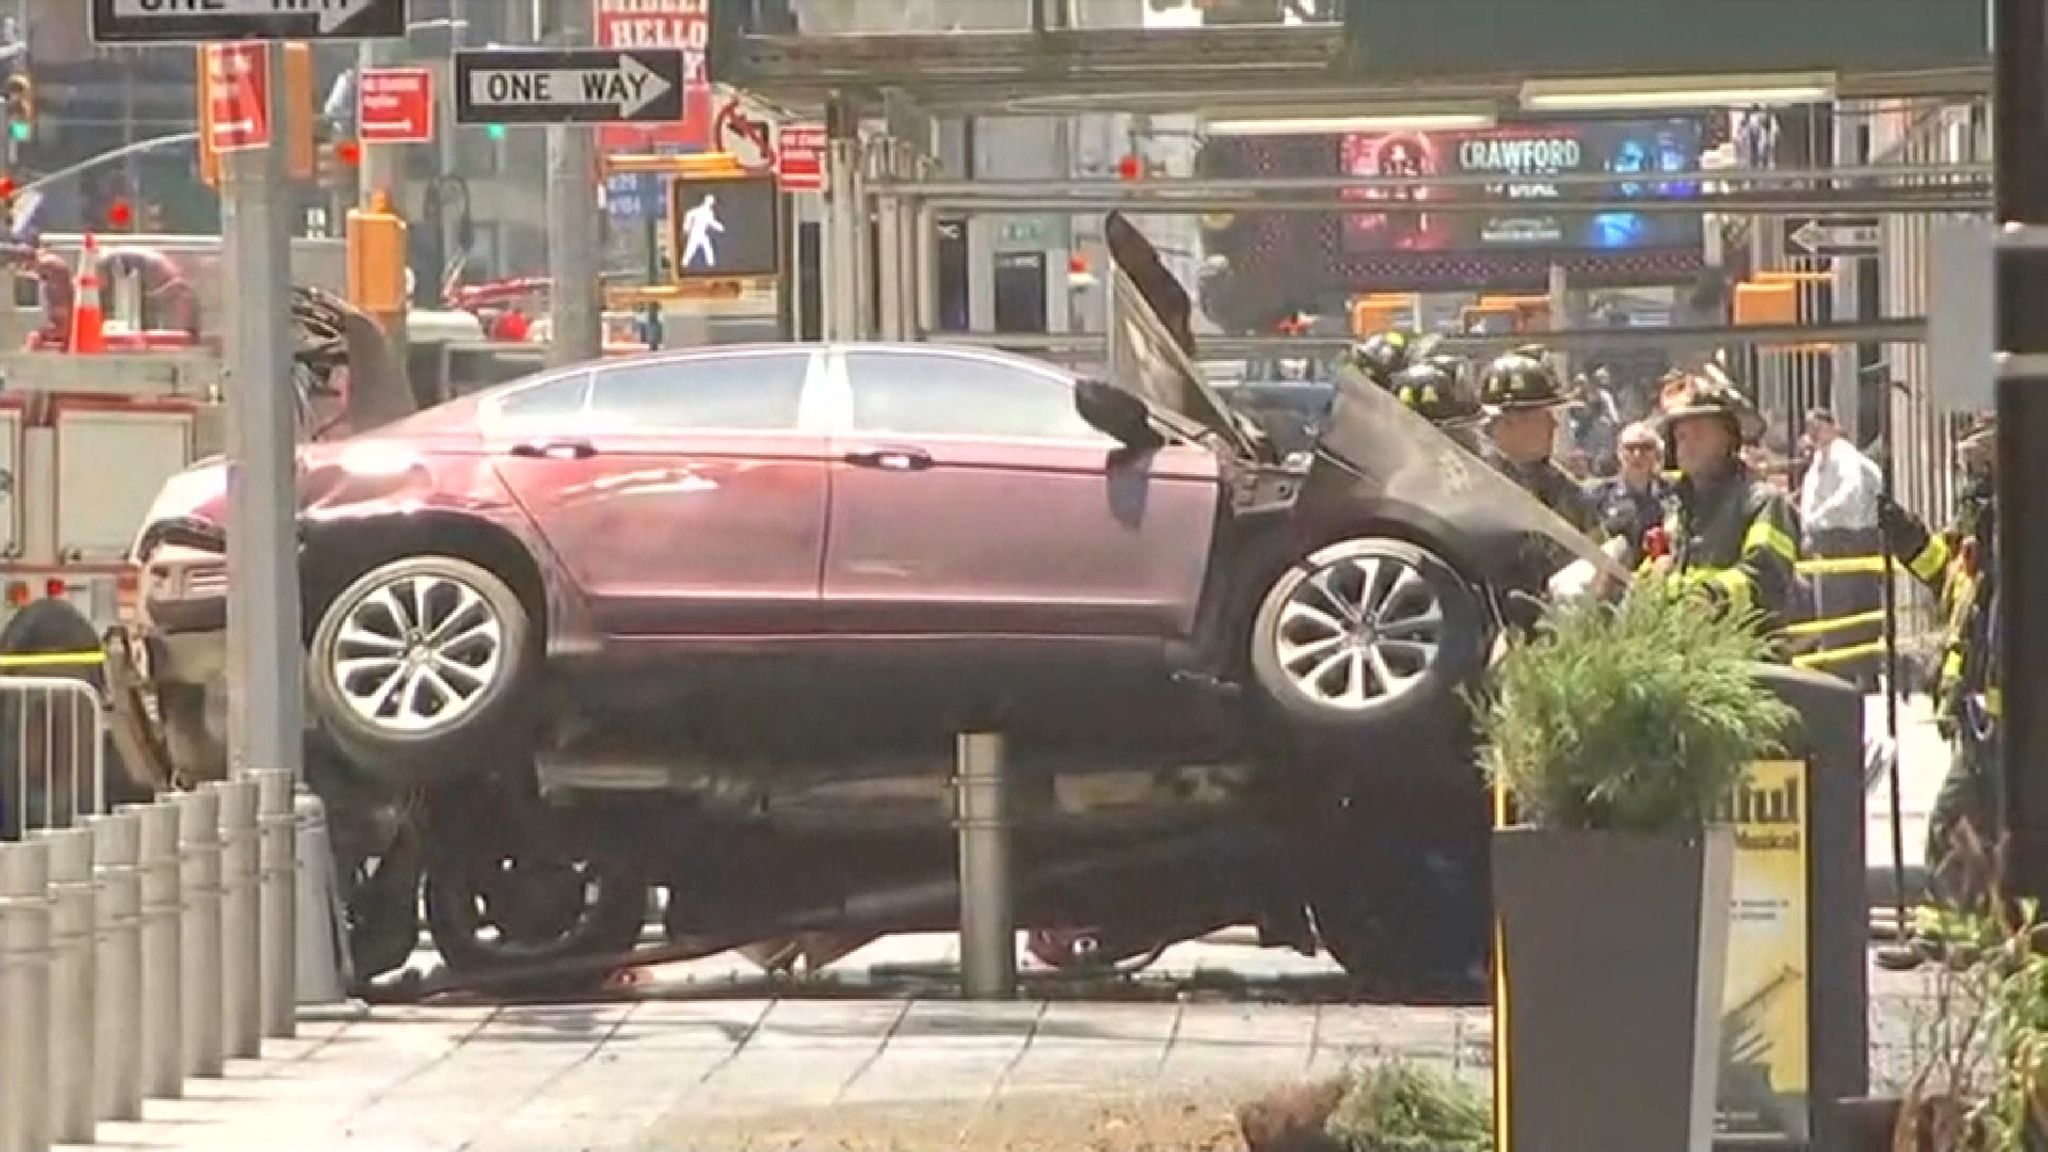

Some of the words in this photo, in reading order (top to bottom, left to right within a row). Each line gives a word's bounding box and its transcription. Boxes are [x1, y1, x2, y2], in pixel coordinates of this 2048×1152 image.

[611, 19, 708, 49] HELLO
[487, 73, 551, 101] ONE
[583, 72, 648, 101] WAY
[1460, 138, 1580, 169] CRAWFORD
